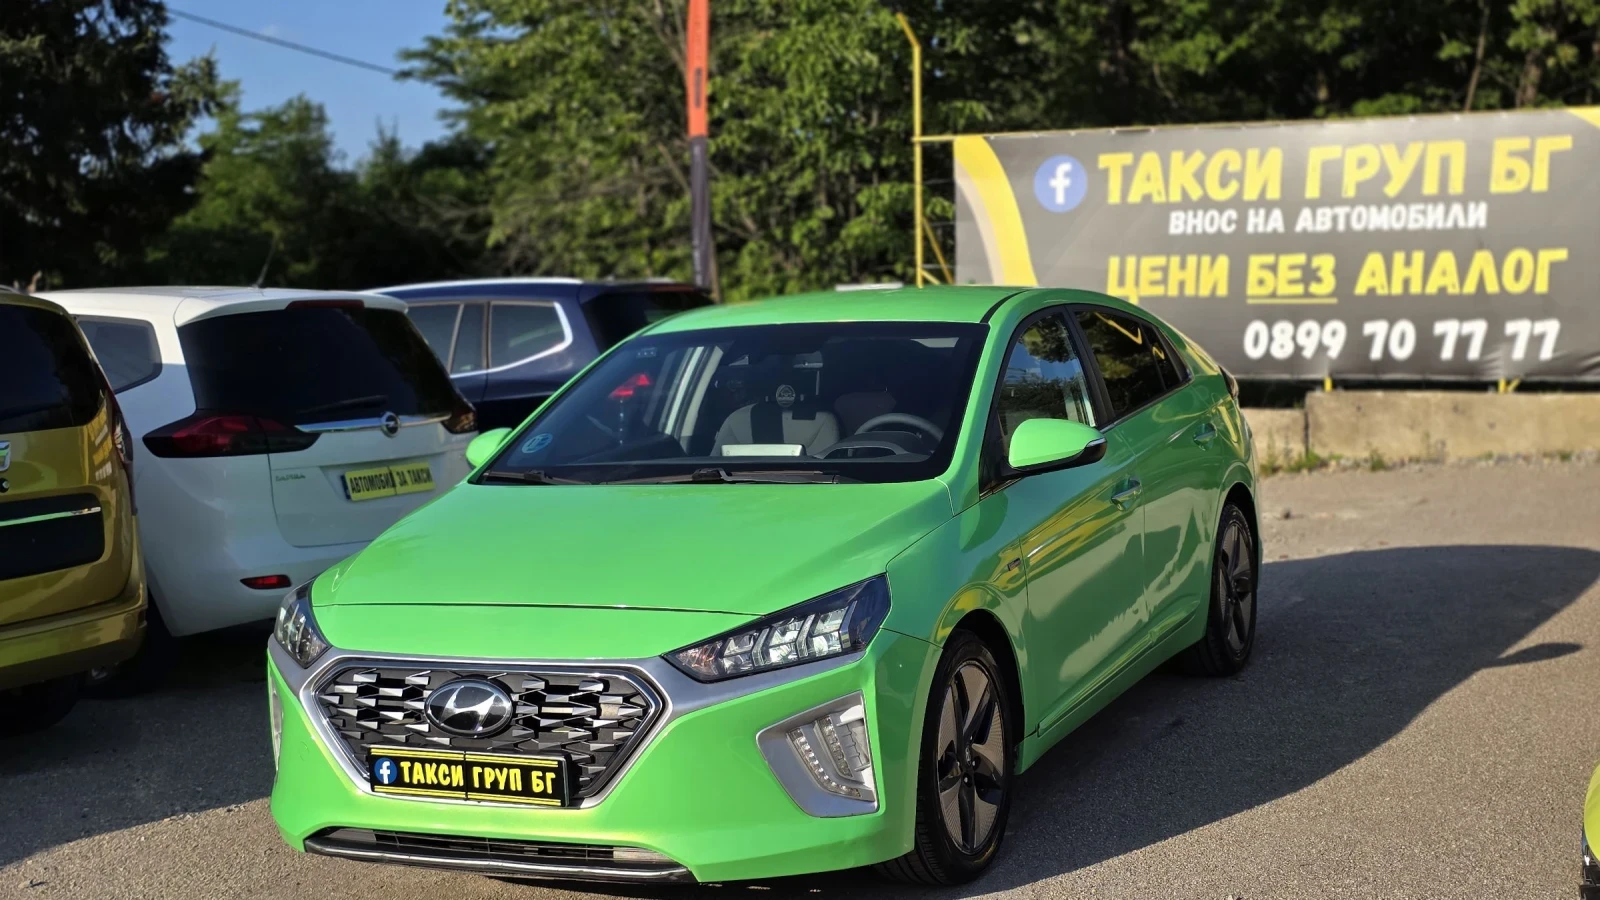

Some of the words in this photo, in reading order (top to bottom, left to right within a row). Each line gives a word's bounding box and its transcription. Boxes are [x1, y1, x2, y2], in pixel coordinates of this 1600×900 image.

[1097, 147, 1283, 204] ТАКСИ
[1304, 140, 1466, 198] ГРУП
[1489, 134, 1573, 194] БГ
[1168, 208, 1238, 235] ВНОС
[1246, 208, 1285, 234] НА
[1295, 201, 1488, 233] АВТОМОБИЛИ
[1107, 254, 1230, 305] ЦЕНИ
[1247, 253, 1336, 296] БЕЗ
[1354, 248, 1568, 295] АНАЛОГ
[1244, 319, 1347, 360] 0899
[1362, 318, 1416, 361] 70
[1433, 318, 1488, 361] 77
[1504, 318, 1560, 361] 77
[396, 470, 409, 487] ЗА
[400, 761, 465, 787] ТАКСИ
[472, 766, 522, 792] ГРУП
[531, 770, 556, 794] БГ
